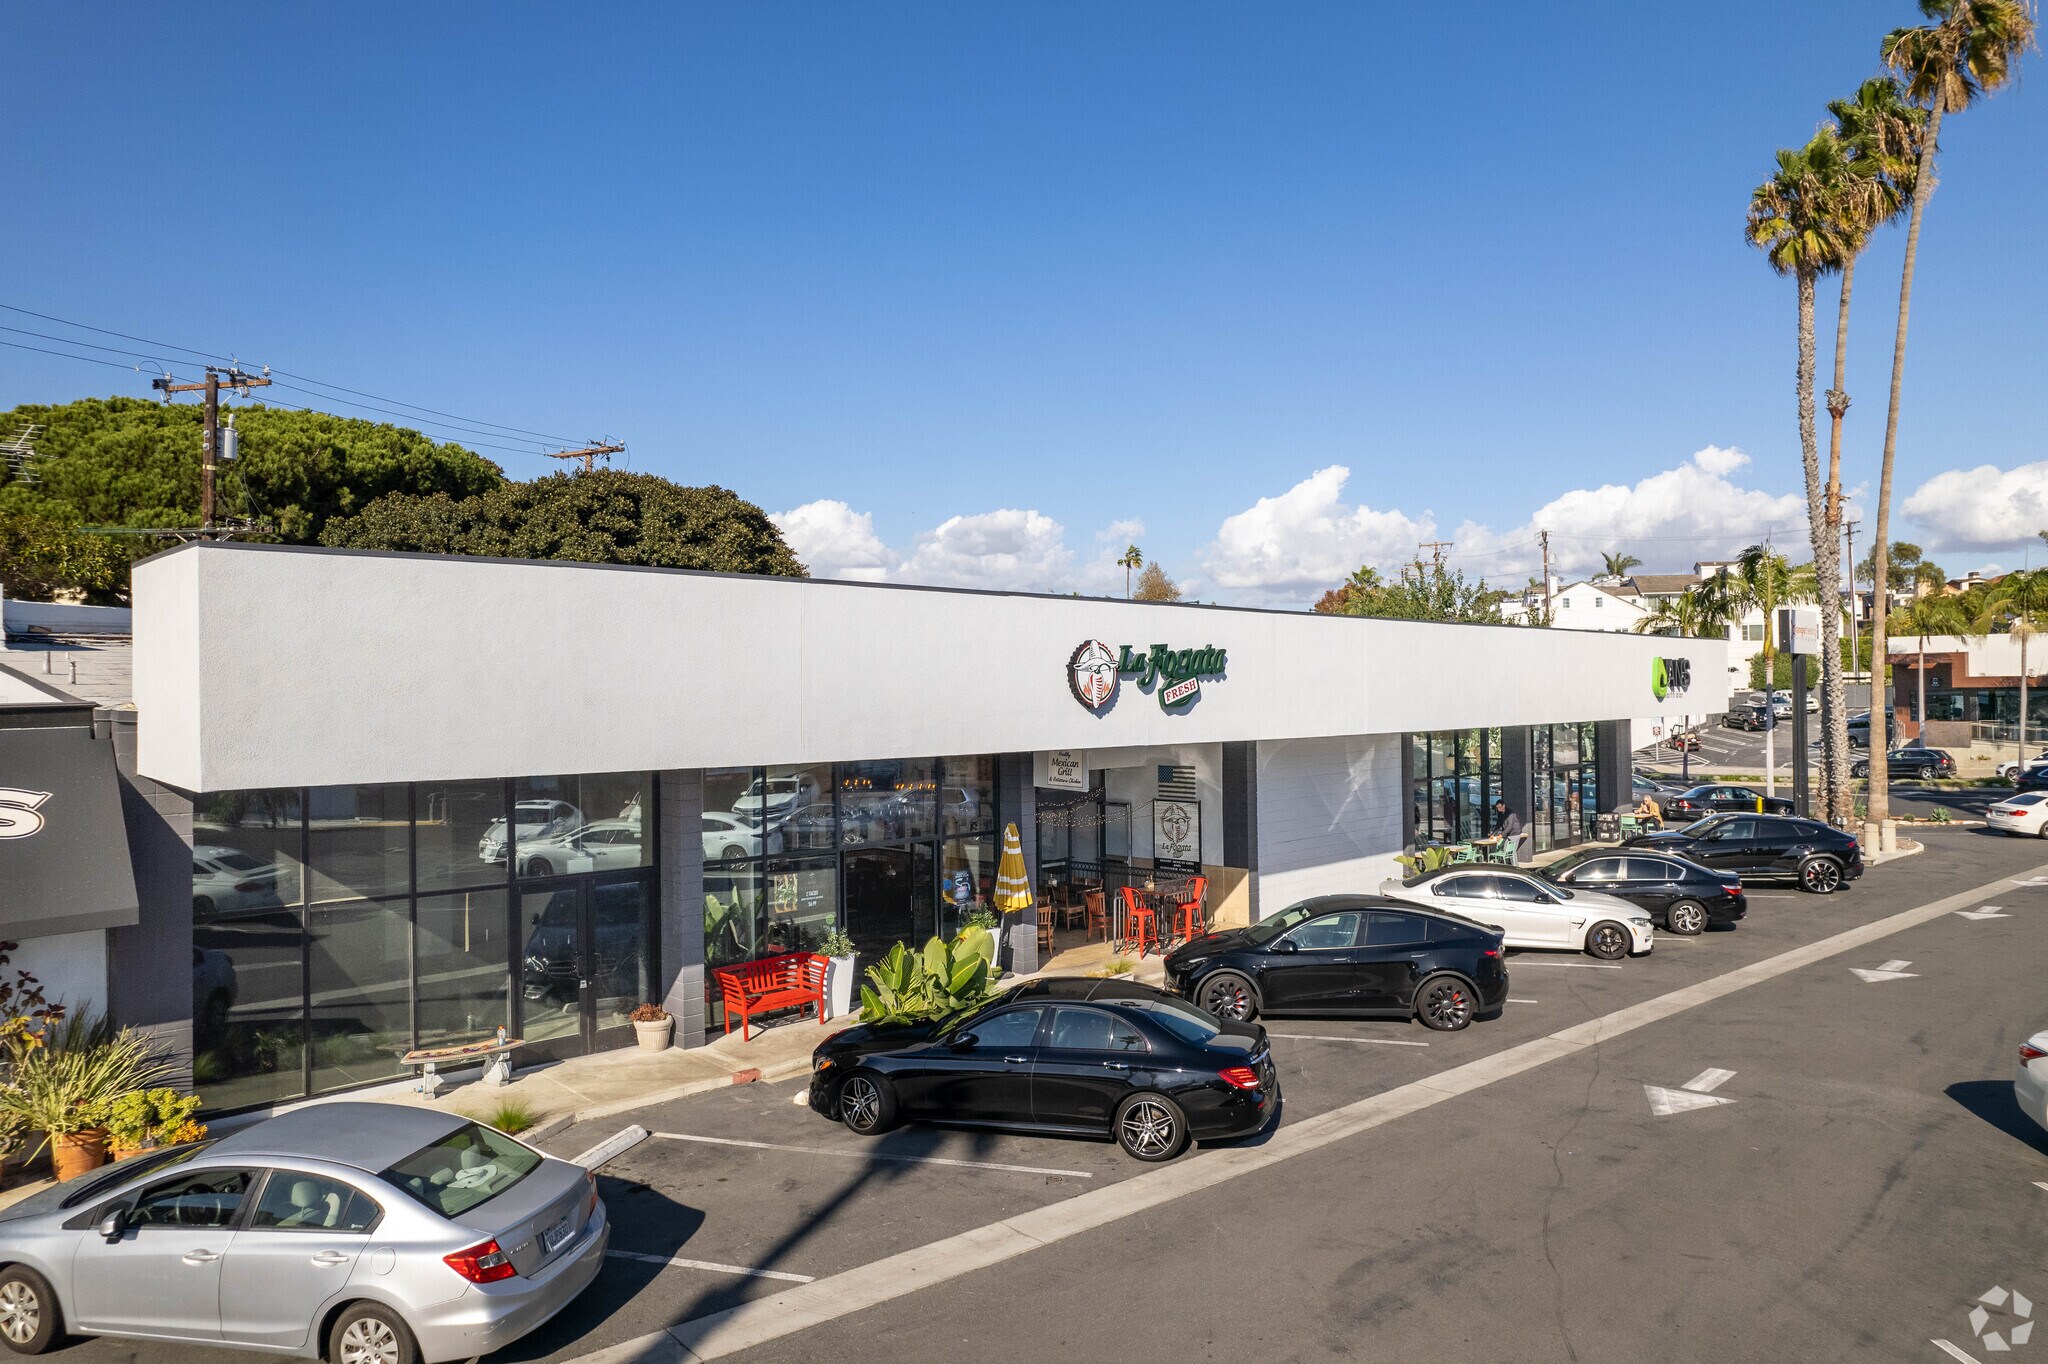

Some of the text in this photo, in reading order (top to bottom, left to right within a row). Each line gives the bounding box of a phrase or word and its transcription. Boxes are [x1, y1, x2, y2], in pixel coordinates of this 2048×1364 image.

[1118, 644, 1227, 686] La Fogata
[1165, 680, 1197, 702] FRESH
[1051, 757, 1080, 768] Mexican
[1057, 767, 1073, 776] Grill
